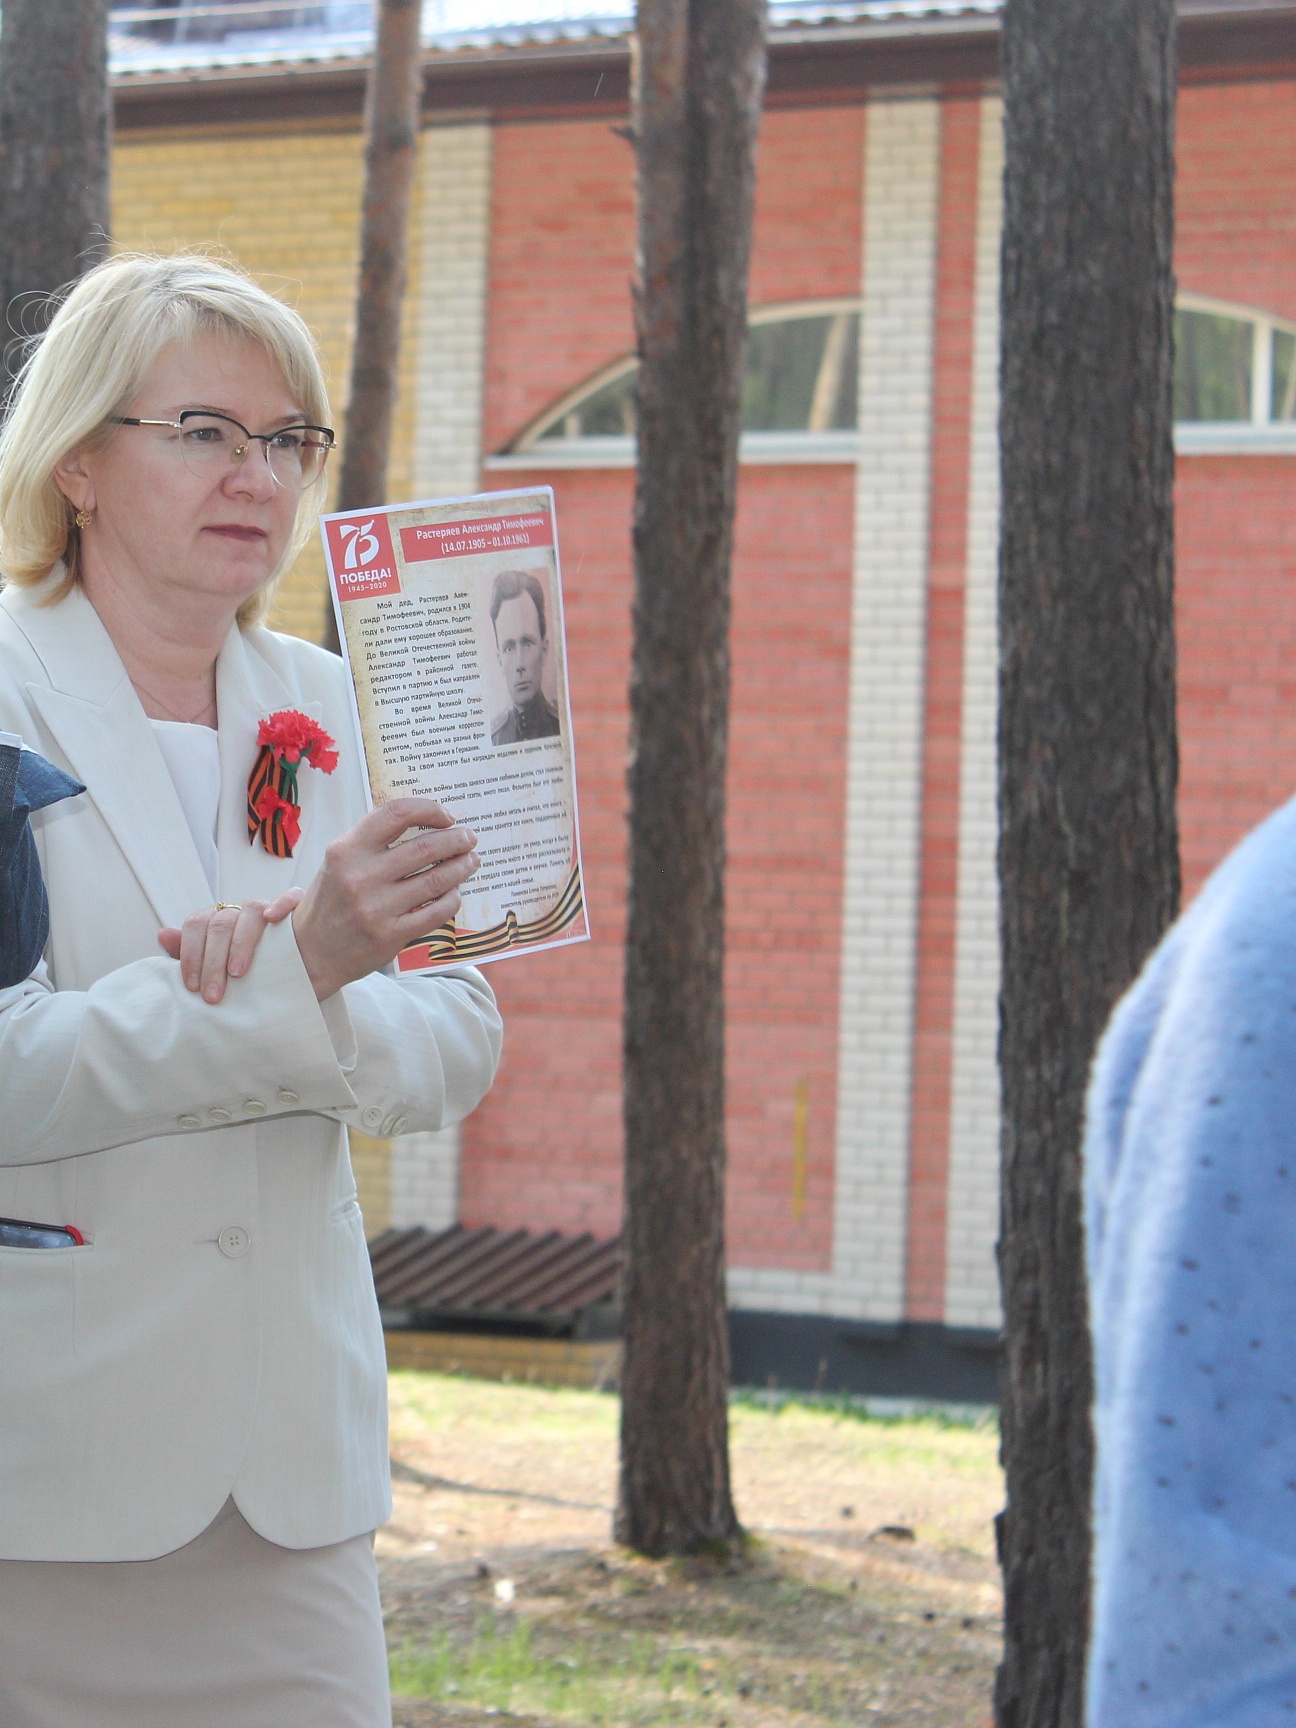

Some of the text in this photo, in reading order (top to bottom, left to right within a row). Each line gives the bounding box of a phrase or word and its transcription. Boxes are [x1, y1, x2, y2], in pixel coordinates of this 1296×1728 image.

[416, 518, 544, 540] Растеряев Александр Тимофеевич
[339, 520, 380, 570] 75
[441, 538, 485, 554] (14.07.1905
[340, 568, 392, 585] ПОБЕДА!
[377, 602, 393, 610] Мой
[399, 599, 413, 608] дед,
[419, 594, 449, 604] Растеряев
[360, 616, 380, 625] сандр
[382, 609, 425, 621] Тимофеевич,
[428, 605, 452, 615] родился
[458, 602, 471, 610] 1904
[362, 628, 378, 637] году
[386, 621, 423, 632] Ростовской
[425, 617, 450, 627] области.
[452, 615, 472, 623] Родите-
[375, 639, 392, 648] дали
[394, 636, 407, 645] ему
[408, 632, 436, 642] хорошее
[437, 627, 474, 638] образование.
[366, 638, 476, 661] До Великой Отечественной войны
[368, 649, 477, 671] Александр Тимофеевич работал
[370, 671, 412, 684] редактором
[425, 665, 454, 675] районной
[372, 684, 400, 695] Вступил
[409, 680, 433, 690] партию
[440, 676, 452, 685] был
[453, 673, 480, 683] направлен
[381, 694, 409, 706] Высшую
[411, 690, 445, 701] партийную
[446, 687, 465, 696] школу.
[411, 704, 431, 713] время
[438, 698, 462, 708] Великой
[378, 719, 411, 730] ственной
[415, 715, 436, 724] войны
[438, 710, 468, 721] Александр
[381, 732, 407, 742] феевич
[411, 729, 425, 737] был
[428, 724, 456, 735] военным
[383, 743, 412, 754] дентом,
[414, 738, 442, 748] побывал
[453, 734, 471, 743] разных
[385, 757, 399, 765] тах.
[400, 753, 421, 763] Войну
[422, 749, 451, 759] закончил
[407, 765, 416, 773] За
[419, 763, 435, 771] свои
[437, 759, 459, 768] заслуги
[460, 756, 471, 764] был
[412, 787, 432, 796] После
[433, 784, 454, 793] войны
[440, 793, 466, 804] районной
[455, 816, 479, 825] имофеевич
